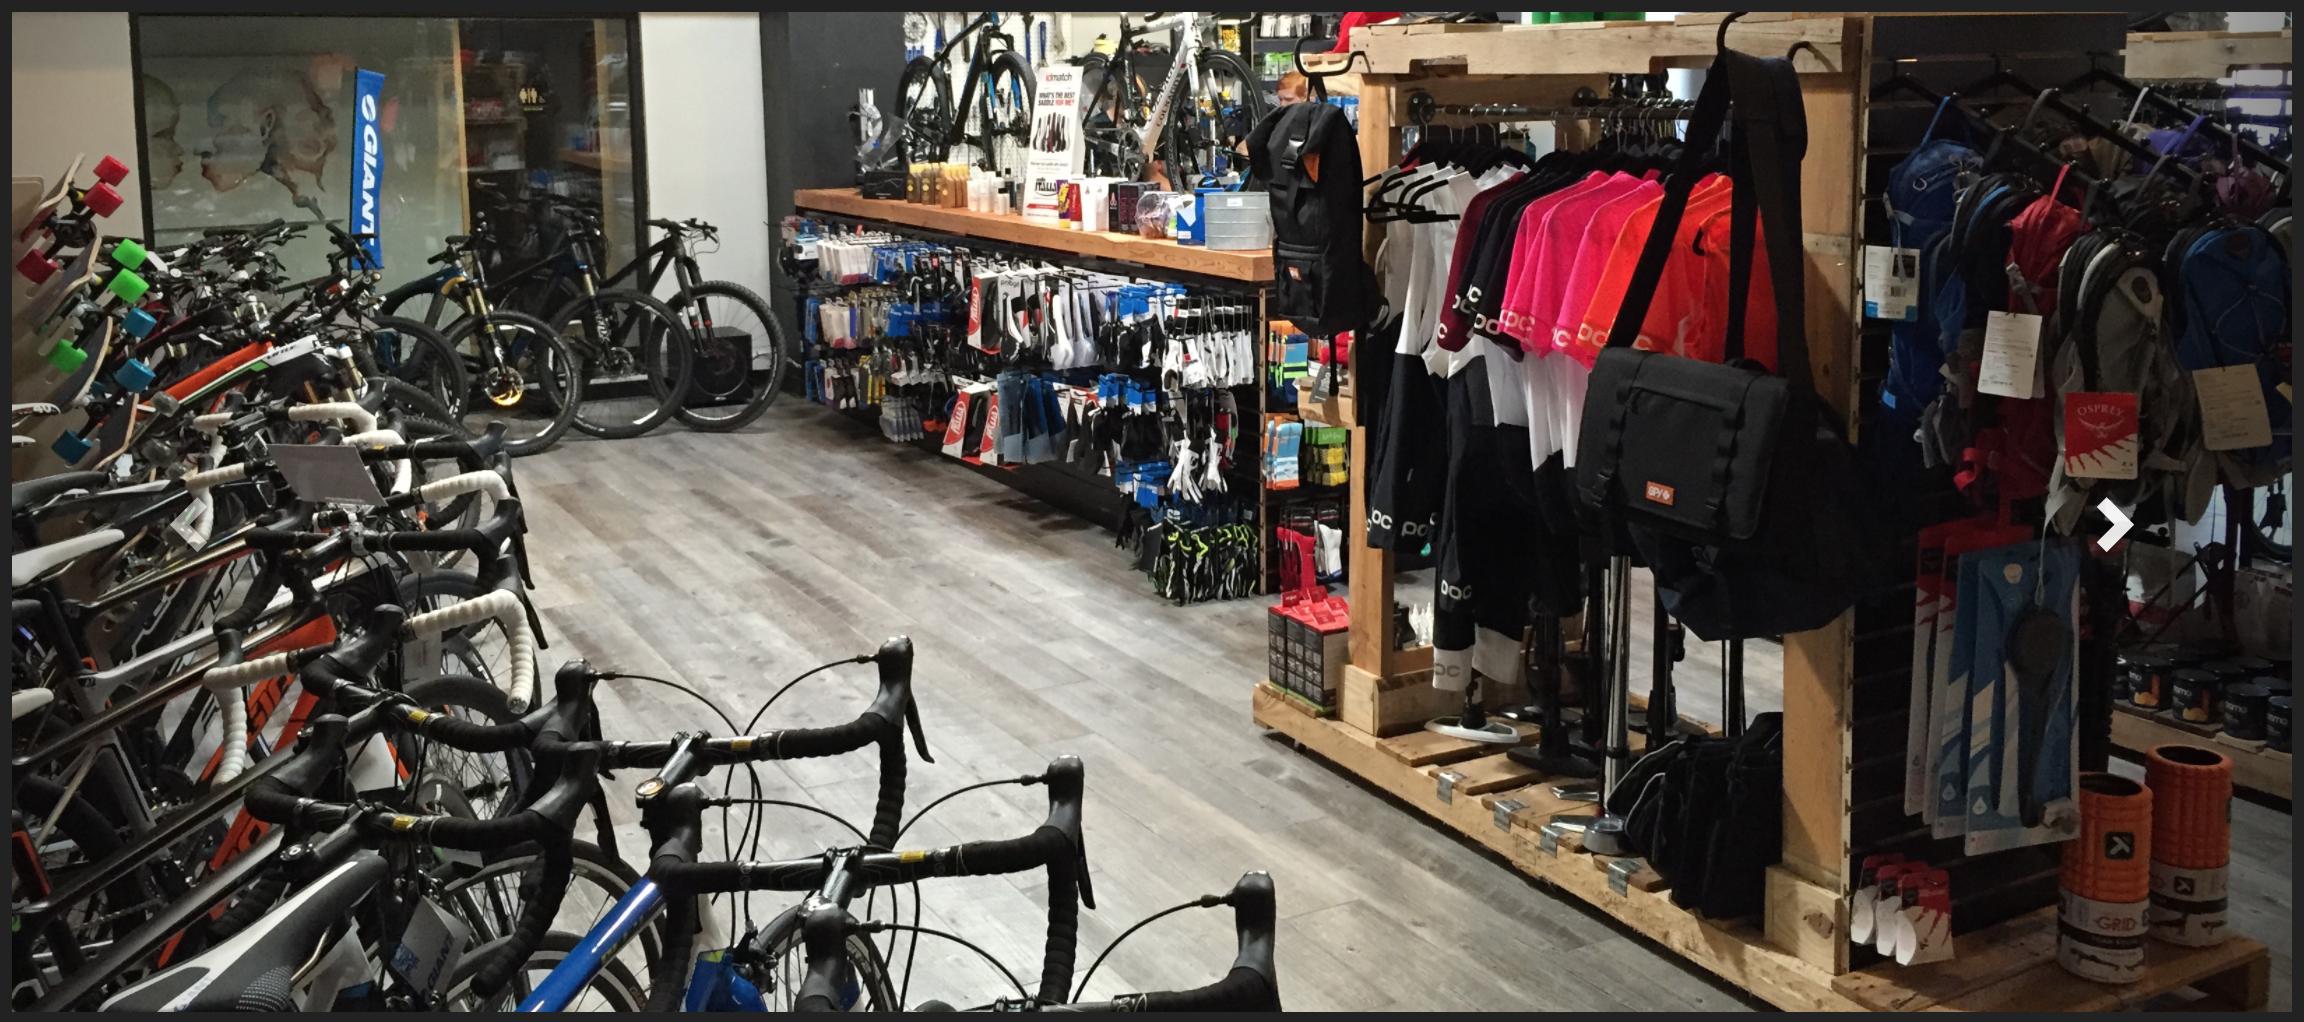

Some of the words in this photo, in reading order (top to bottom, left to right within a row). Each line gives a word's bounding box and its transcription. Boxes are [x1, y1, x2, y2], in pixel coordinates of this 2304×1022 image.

[361, 124, 378, 246] GIANT
[2077, 403, 2125, 417] OSPREY
[2097, 916, 2137, 931] GRID
